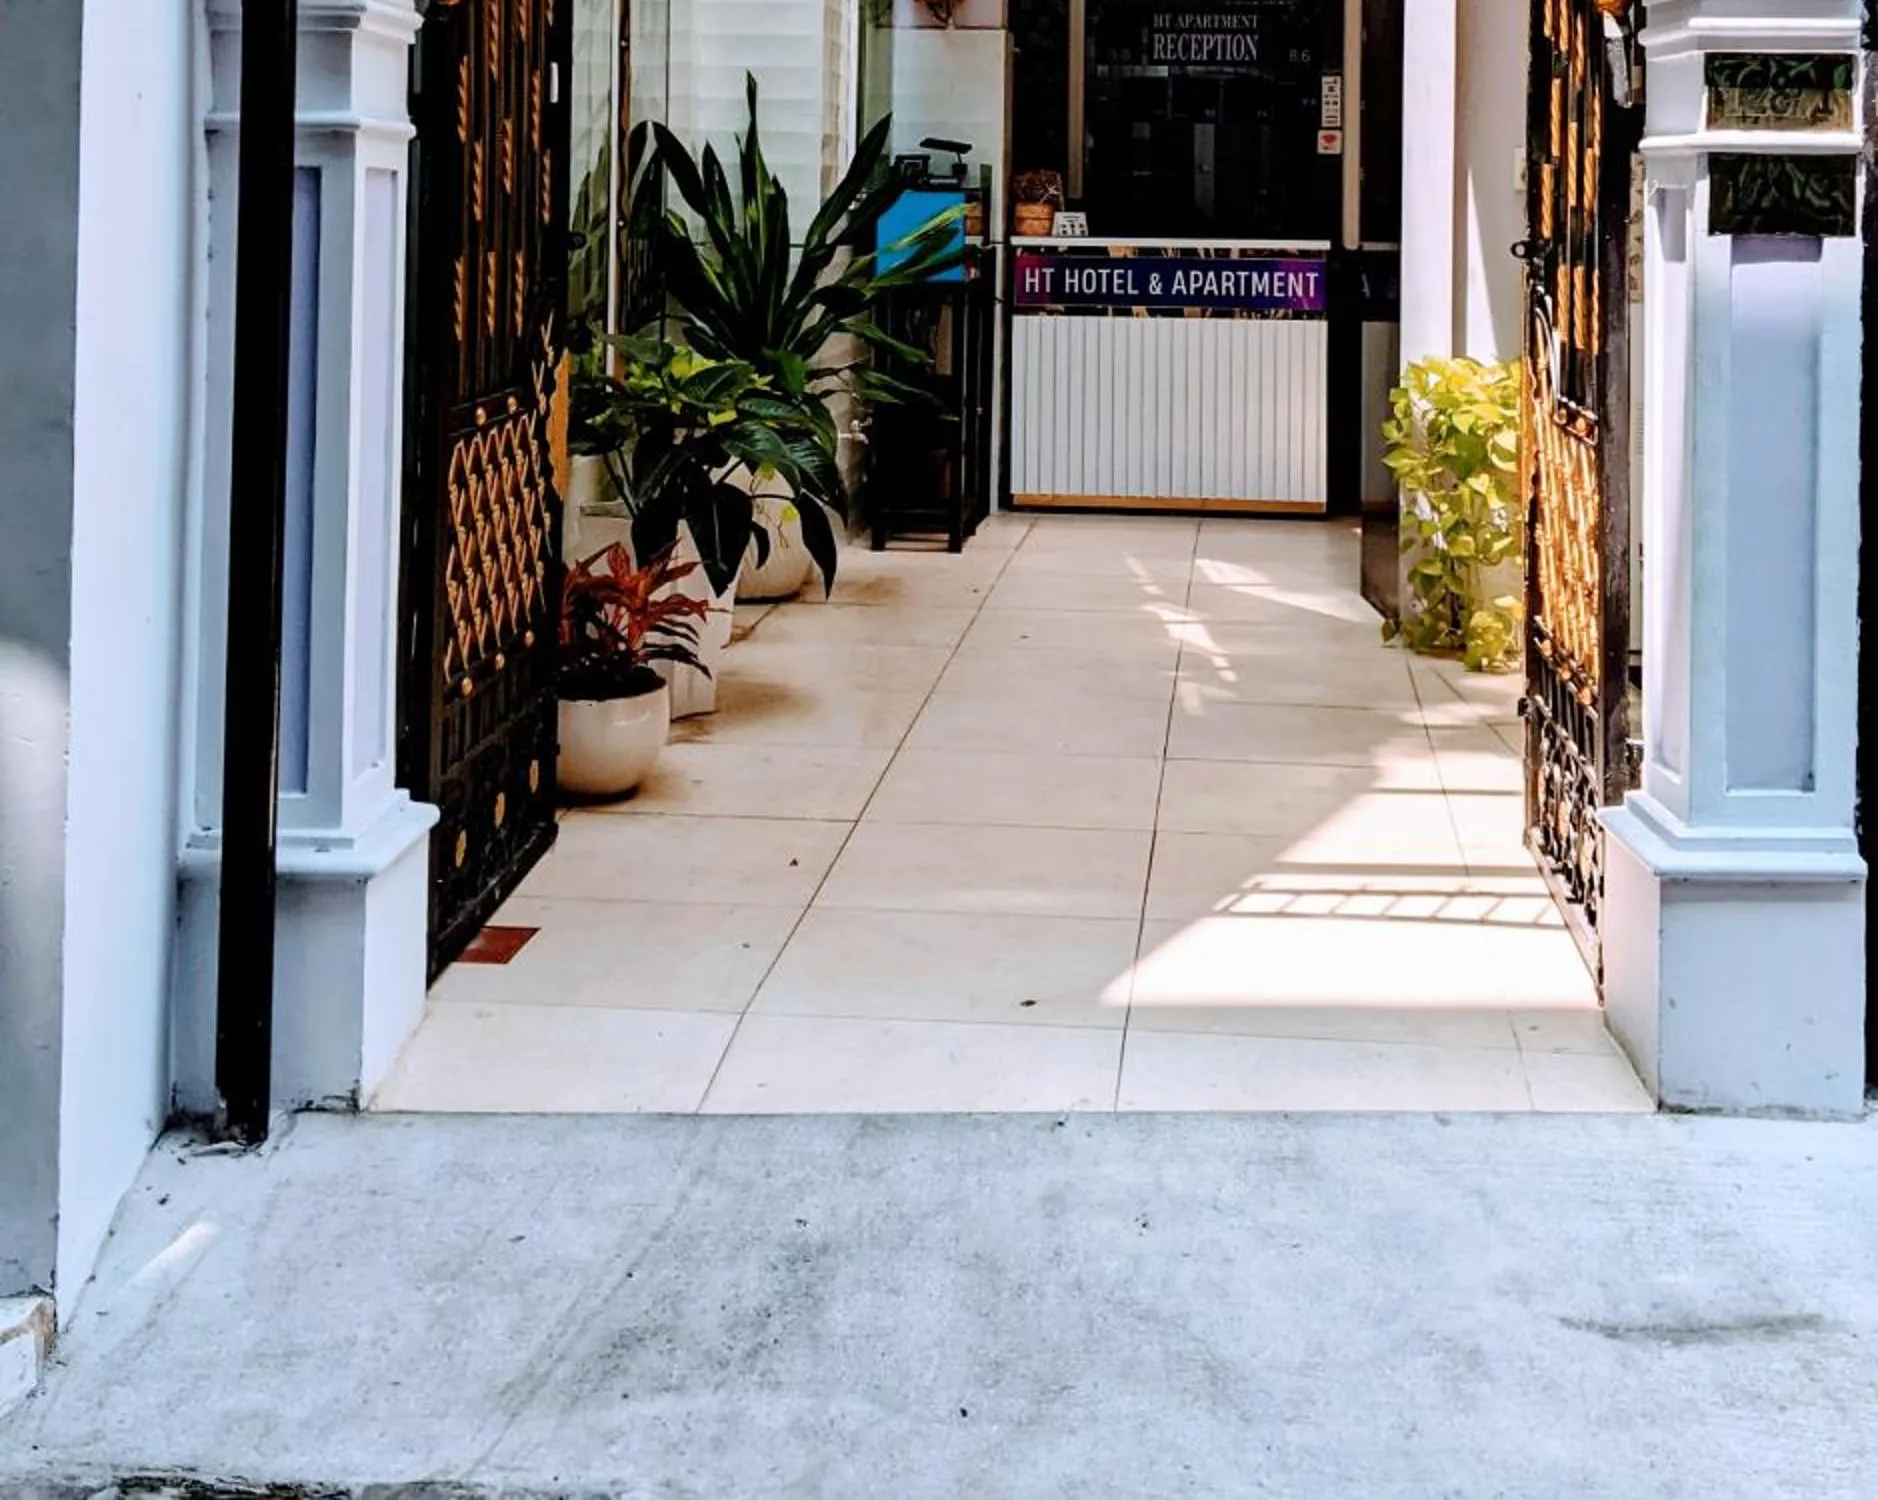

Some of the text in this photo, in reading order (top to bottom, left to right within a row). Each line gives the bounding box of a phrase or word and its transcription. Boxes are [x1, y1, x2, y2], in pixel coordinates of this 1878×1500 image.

[1153, 13, 1259, 29] HT APARTMENT
[1153, 33, 1259, 61] RECEPTION
[1025, 266, 1319, 299] HT HOTEL & APARTMENT
